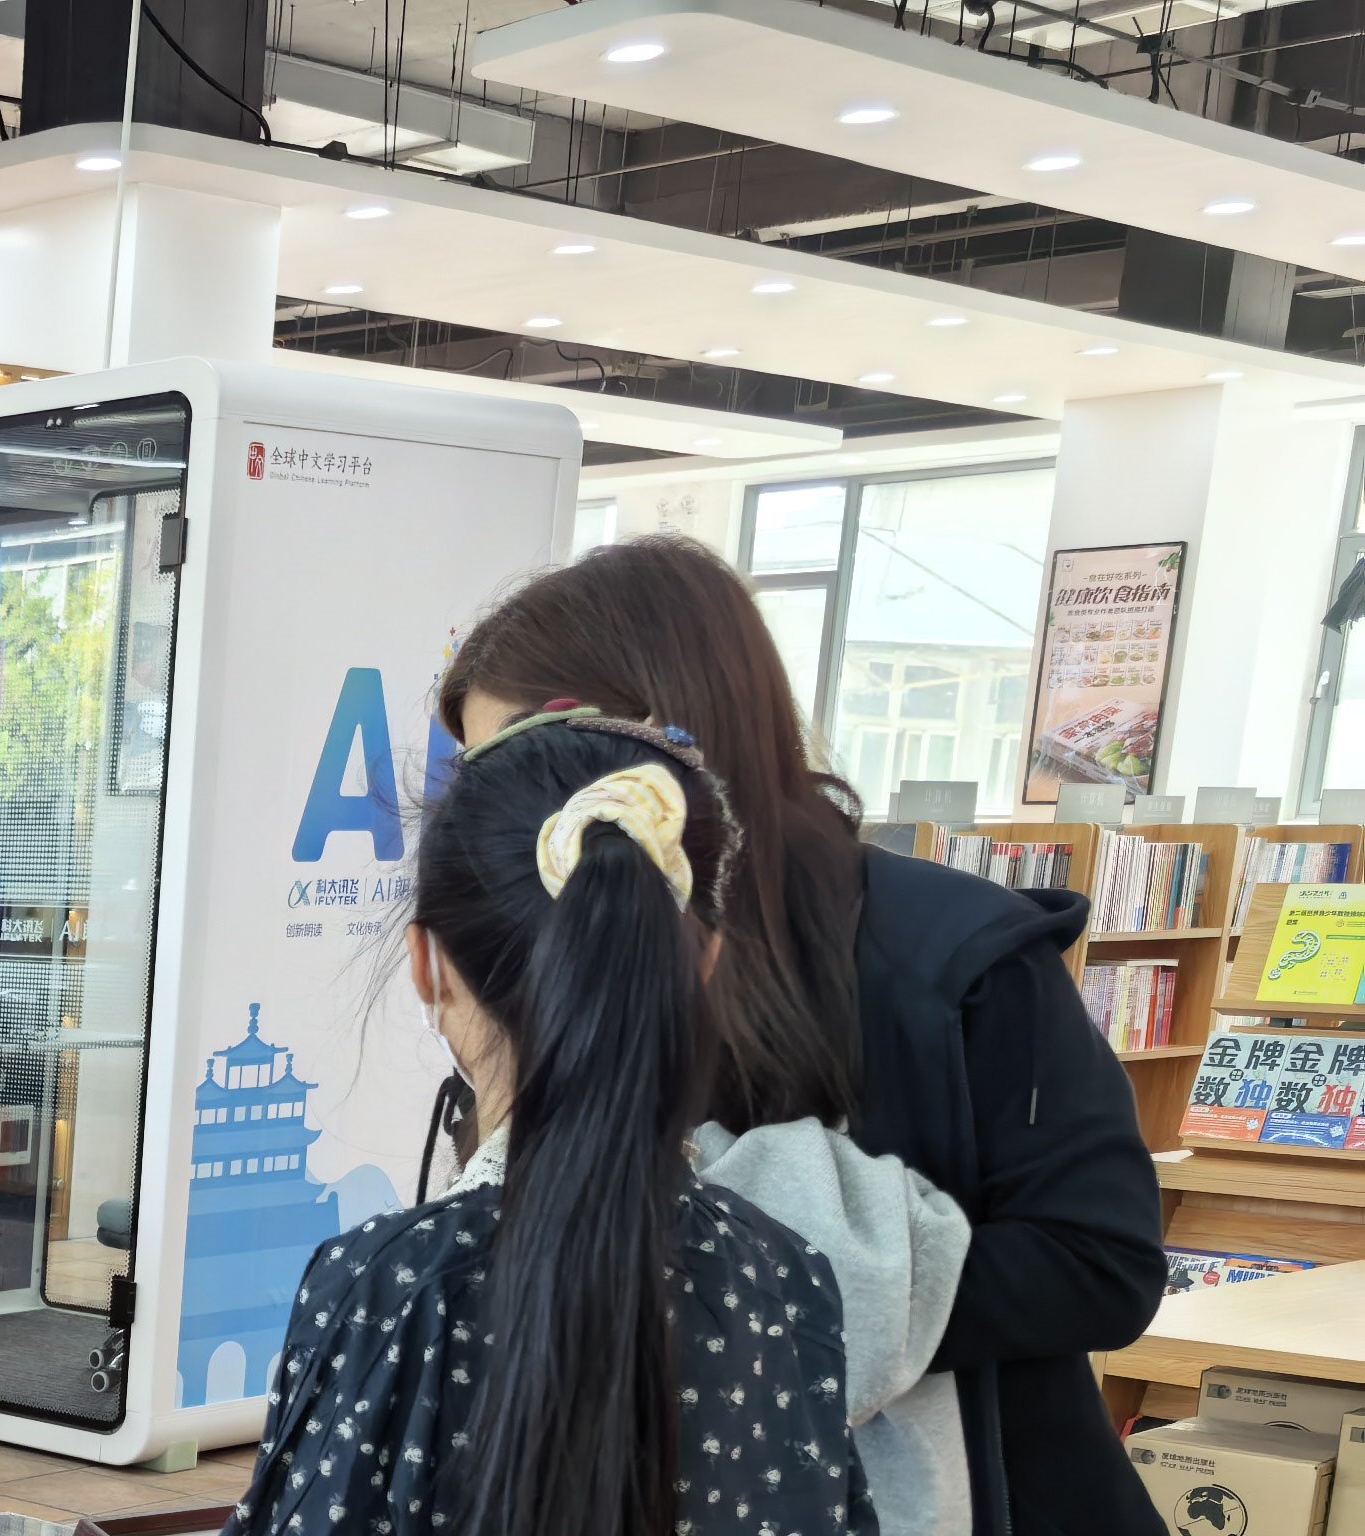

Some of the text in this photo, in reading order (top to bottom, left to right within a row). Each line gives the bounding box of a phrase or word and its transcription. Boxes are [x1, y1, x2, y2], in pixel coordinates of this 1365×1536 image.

[271, 446, 373, 475] 全球中文学习平台
[1055, 582, 1173, 606] 健康饮食指南
[315, 878, 359, 894] 科大讯飞
[286, 922, 323, 938] 创新朗读
[346, 921, 382, 936] 文化传承
[1203, 1037, 1285, 1071] 金牌
[1285, 1042, 1365, 1076] 金牌
[1190, 1075, 1272, 1110] 数独
[1272, 1081, 1357, 1116] 数独
